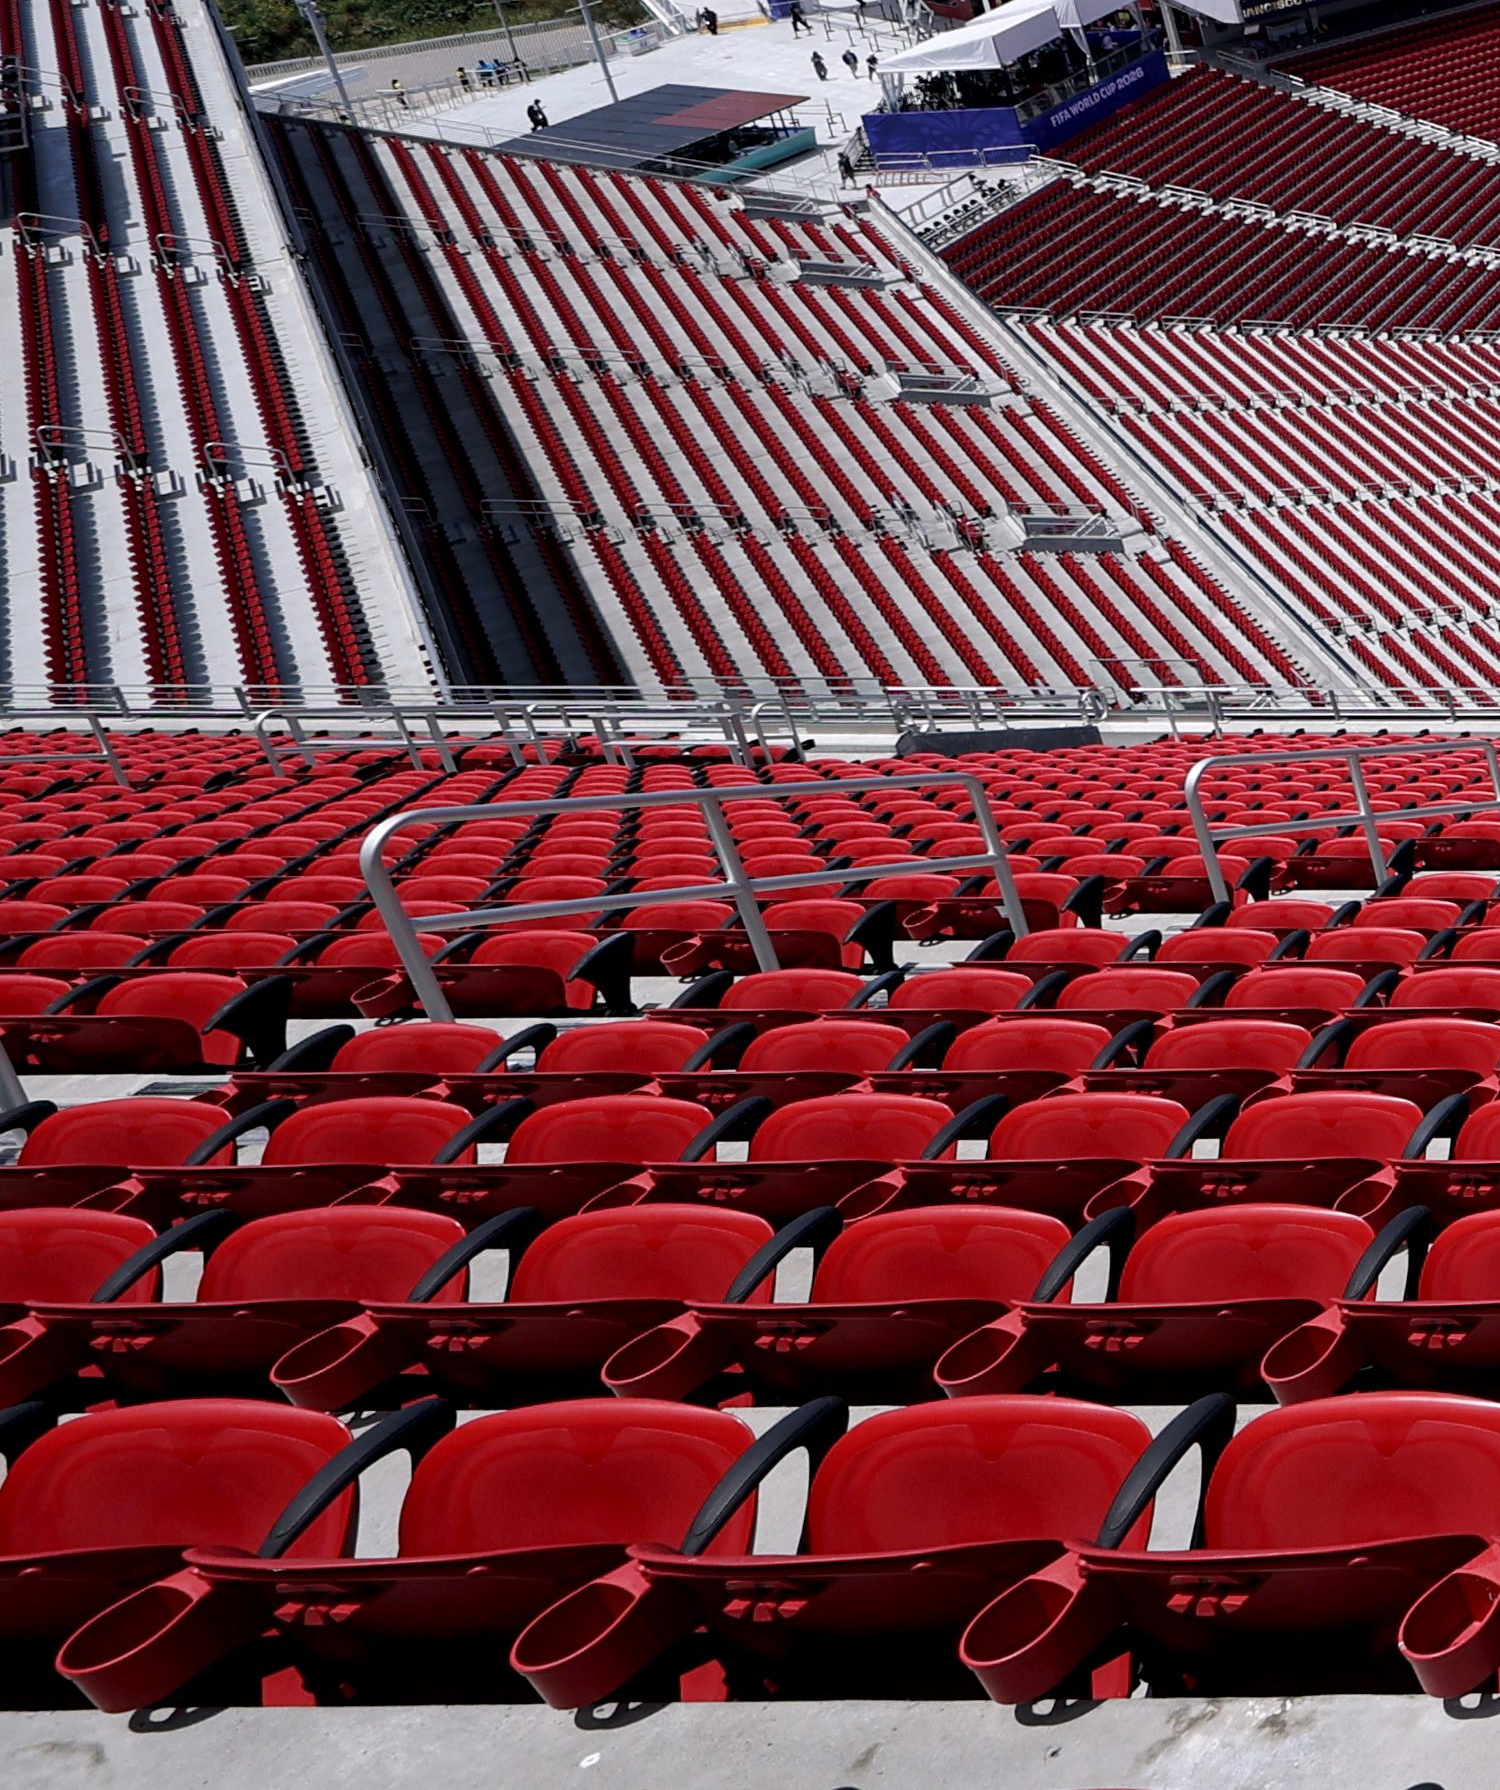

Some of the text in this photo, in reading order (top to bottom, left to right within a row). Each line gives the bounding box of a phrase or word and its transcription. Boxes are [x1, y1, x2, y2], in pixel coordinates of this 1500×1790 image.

[1050, 67, 1144, 128] FIFA WORLD CUP 2026
